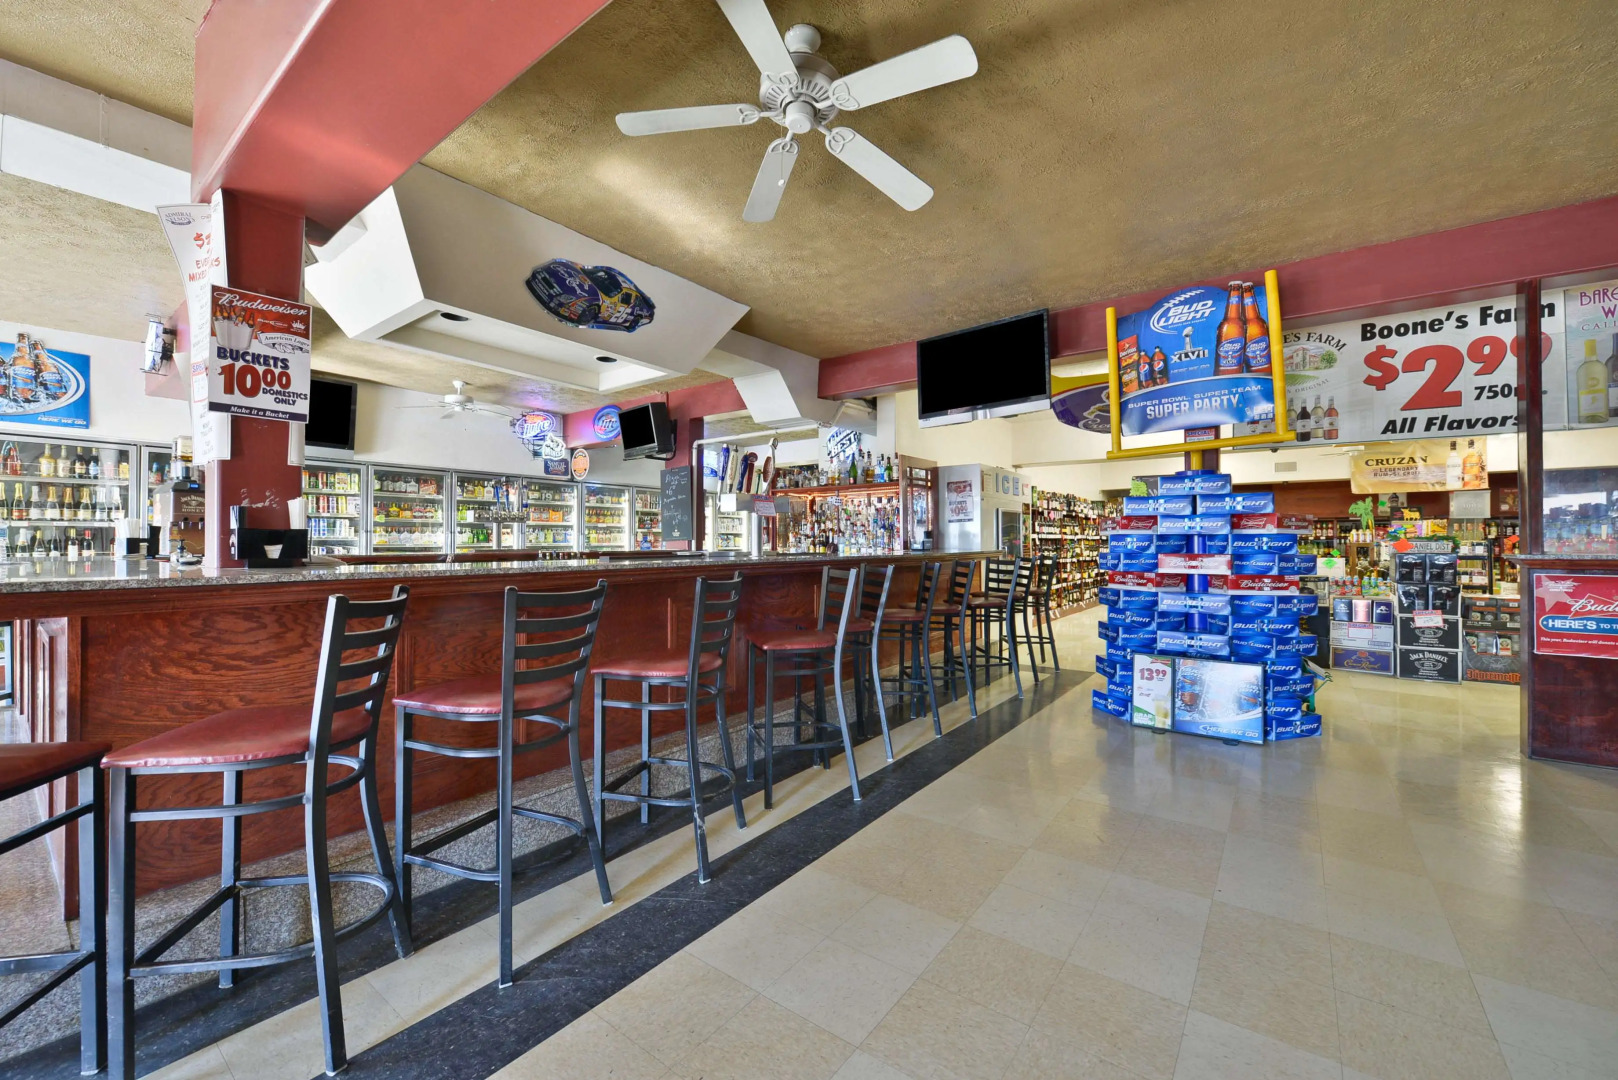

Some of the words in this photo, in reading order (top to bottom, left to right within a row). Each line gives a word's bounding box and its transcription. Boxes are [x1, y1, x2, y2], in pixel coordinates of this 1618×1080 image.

[214, 291, 308, 316] Budweiser
[1167, 300, 1213, 317] BUD
[608, 306, 631, 322] 26
[1158, 307, 1216, 327] LIGHT
[1361, 311, 1469, 342] Boone's
[1480, 302, 1555, 326] Fam
[1306, 332, 1347, 352] FARM
[217, 346, 290, 371] BUCKETS
[1170, 350, 1209, 363] XLVII
[1295, 379, 1329, 393] ORIGINAL
[262, 387, 308, 400] DOMESTICS
[1128, 400, 1159, 409] SUPER
[1162, 396, 1191, 404] BOWL.
[1194, 390, 1228, 398] SUPER
[1231, 386, 1264, 394] TEAM.
[274, 397, 297, 406] ONLY
[1147, 402, 1190, 419] SUPER
[1194, 394, 1243, 413] PARTY.
[230, 406, 250, 415] Make
[265, 410, 290, 419] Bucket
[1381, 417, 1417, 435] All
[1424, 414, 1518, 432] Flavors
[1365, 456, 1429, 467] CRUZAN
[996, 472, 1019, 496] ICE
[1436, 542, 1450, 551] DIST
[1114, 575, 1147, 583] Budweiser
[1130, 615, 1150, 623] LIGHT
[1548, 619, 1597, 630] HERE'S
[1108, 648, 1124, 656] BUD
[1409, 652, 1424, 661] JACK
[1424, 651, 1448, 663] DANIEL'S
[1108, 684, 1125, 692] BUD
[1093, 696, 1106, 704] BUD
[1108, 701, 1125, 712] LIGHT
[1207, 726, 1229, 734] HERE
[1299, 723, 1319, 731] LIGHT
